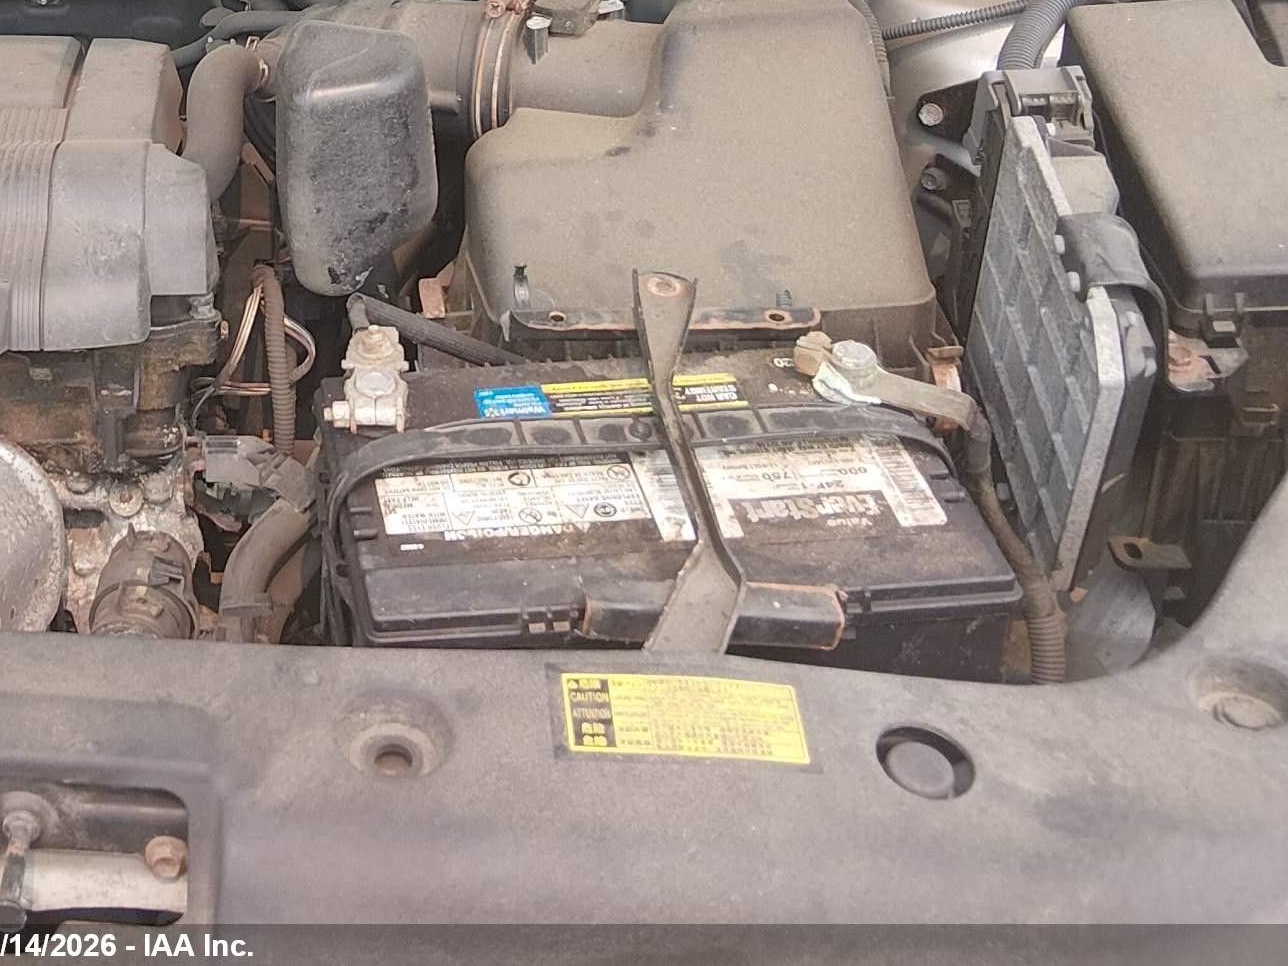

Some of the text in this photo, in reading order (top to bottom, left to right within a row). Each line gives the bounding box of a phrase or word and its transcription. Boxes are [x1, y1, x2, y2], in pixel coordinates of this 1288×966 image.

[500, 405, 547, 417] Walmart
[760, 472, 791, 482] 750
[741, 493, 880, 522] EverStart
[825, 517, 873, 527] Value
[569, 691, 609, 703] CAUTION
